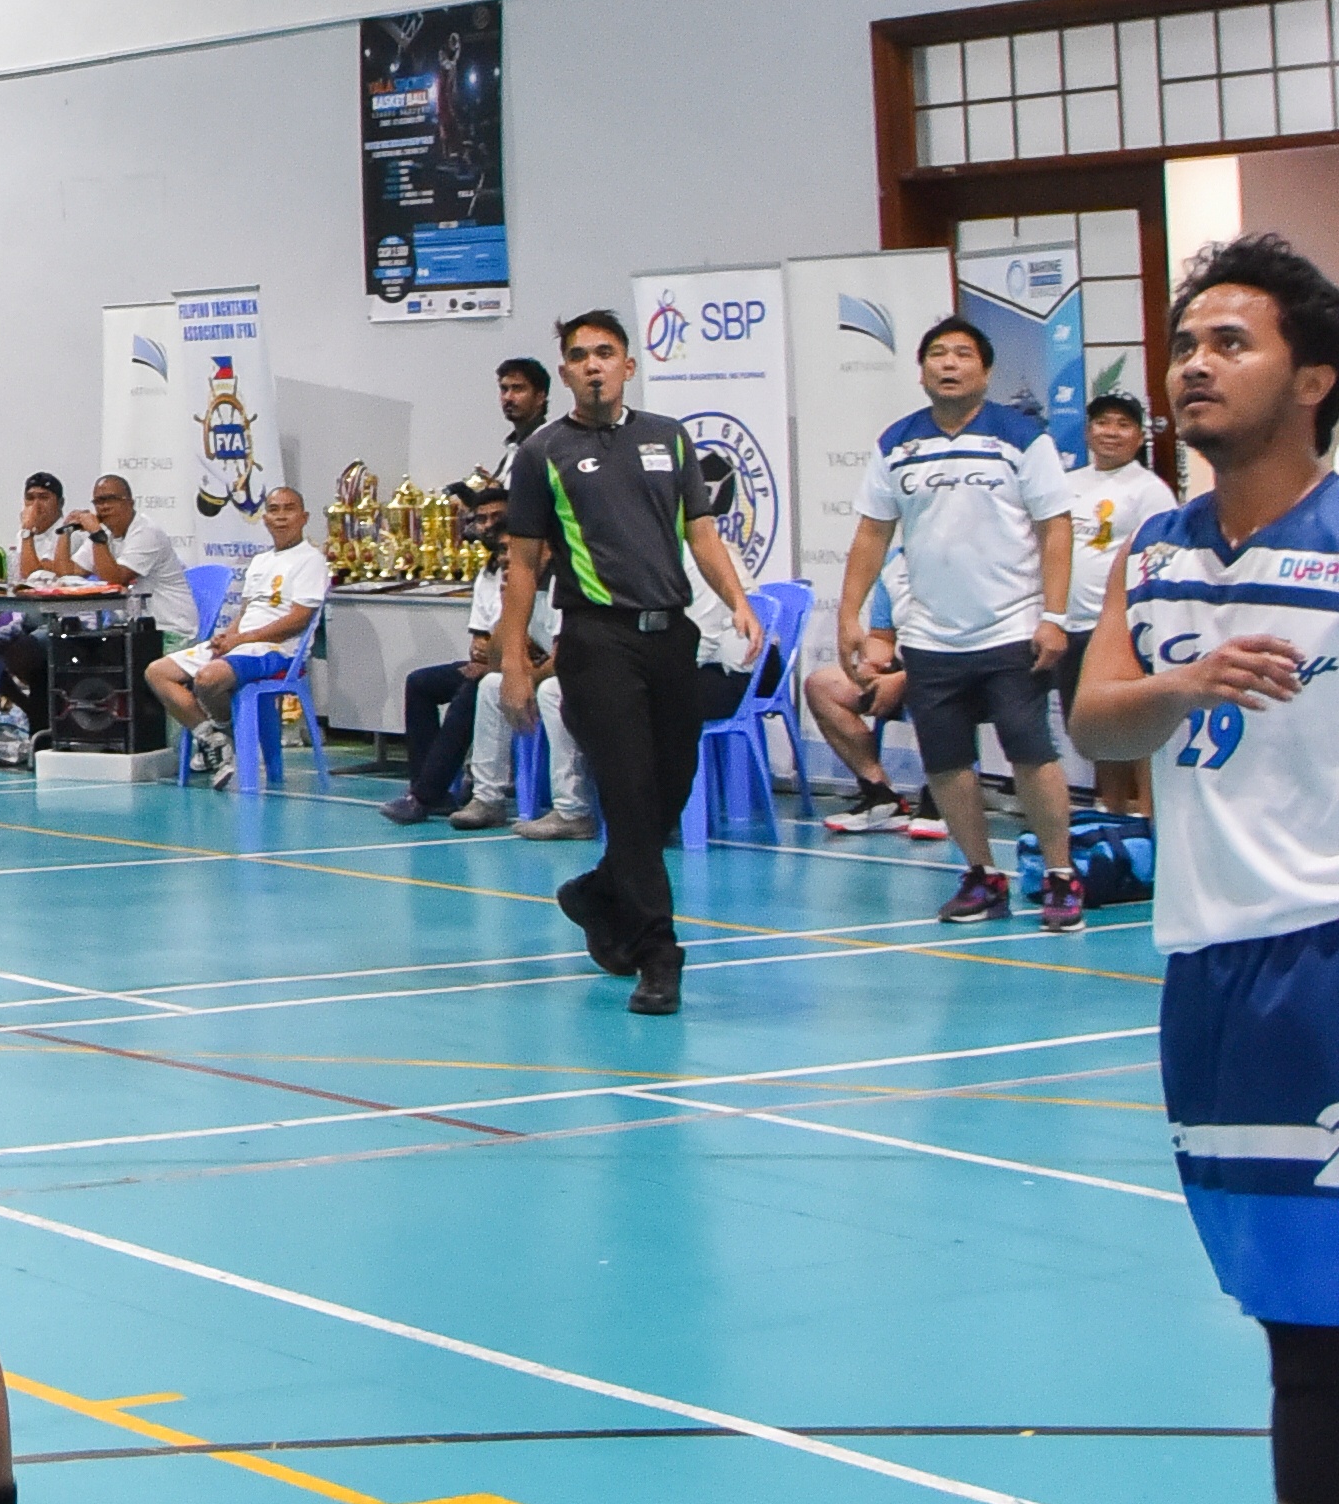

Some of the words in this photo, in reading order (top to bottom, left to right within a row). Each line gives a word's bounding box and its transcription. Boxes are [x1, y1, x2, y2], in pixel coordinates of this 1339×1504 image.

[183, 324, 234, 341] ASSOCIATION
[700, 300, 766, 342] SBP
[216, 433, 243, 452] FYA
[1176, 701, 1245, 770] 29
